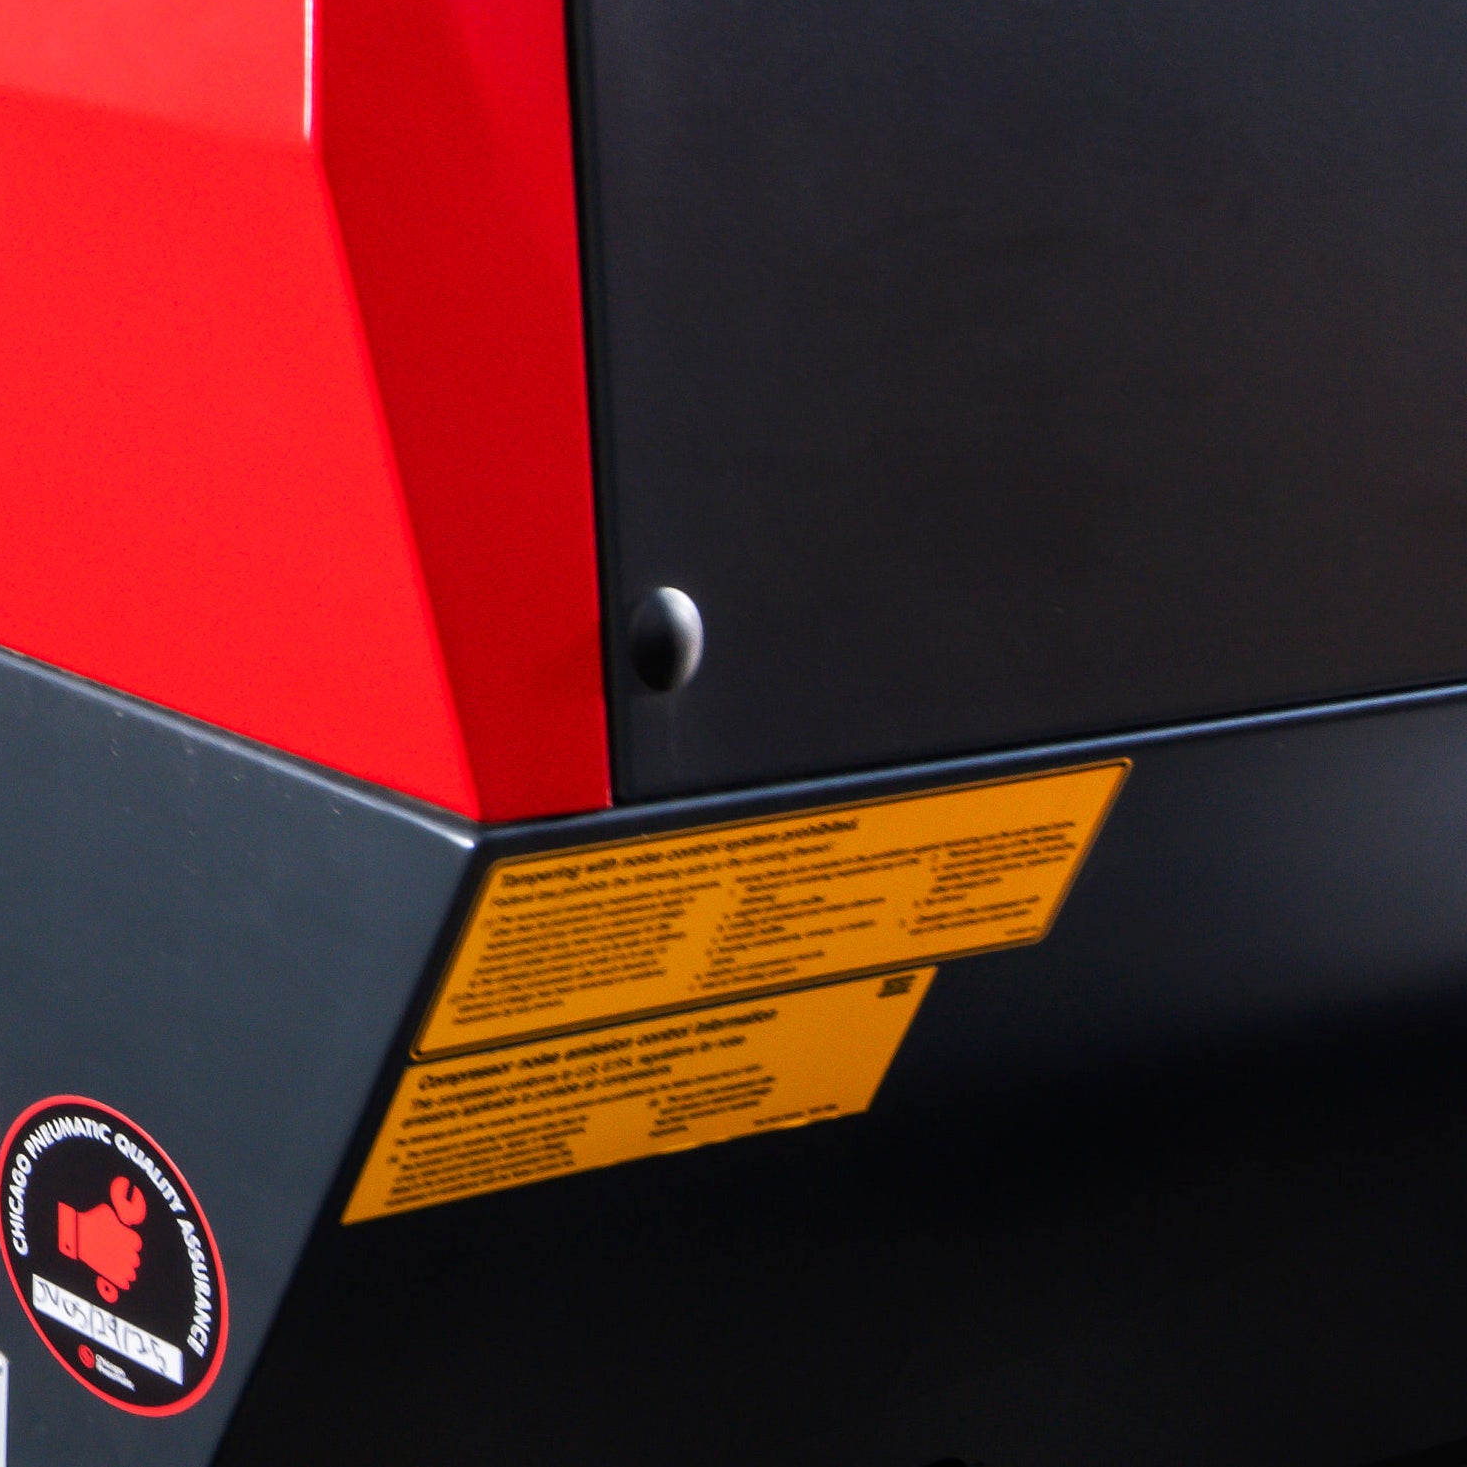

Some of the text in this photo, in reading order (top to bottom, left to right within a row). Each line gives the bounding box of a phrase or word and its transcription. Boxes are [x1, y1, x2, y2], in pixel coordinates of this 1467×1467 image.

[8, 1116, 213, 1358] CHICAGO PNEUMATIC QUALITY ASSURANCE
